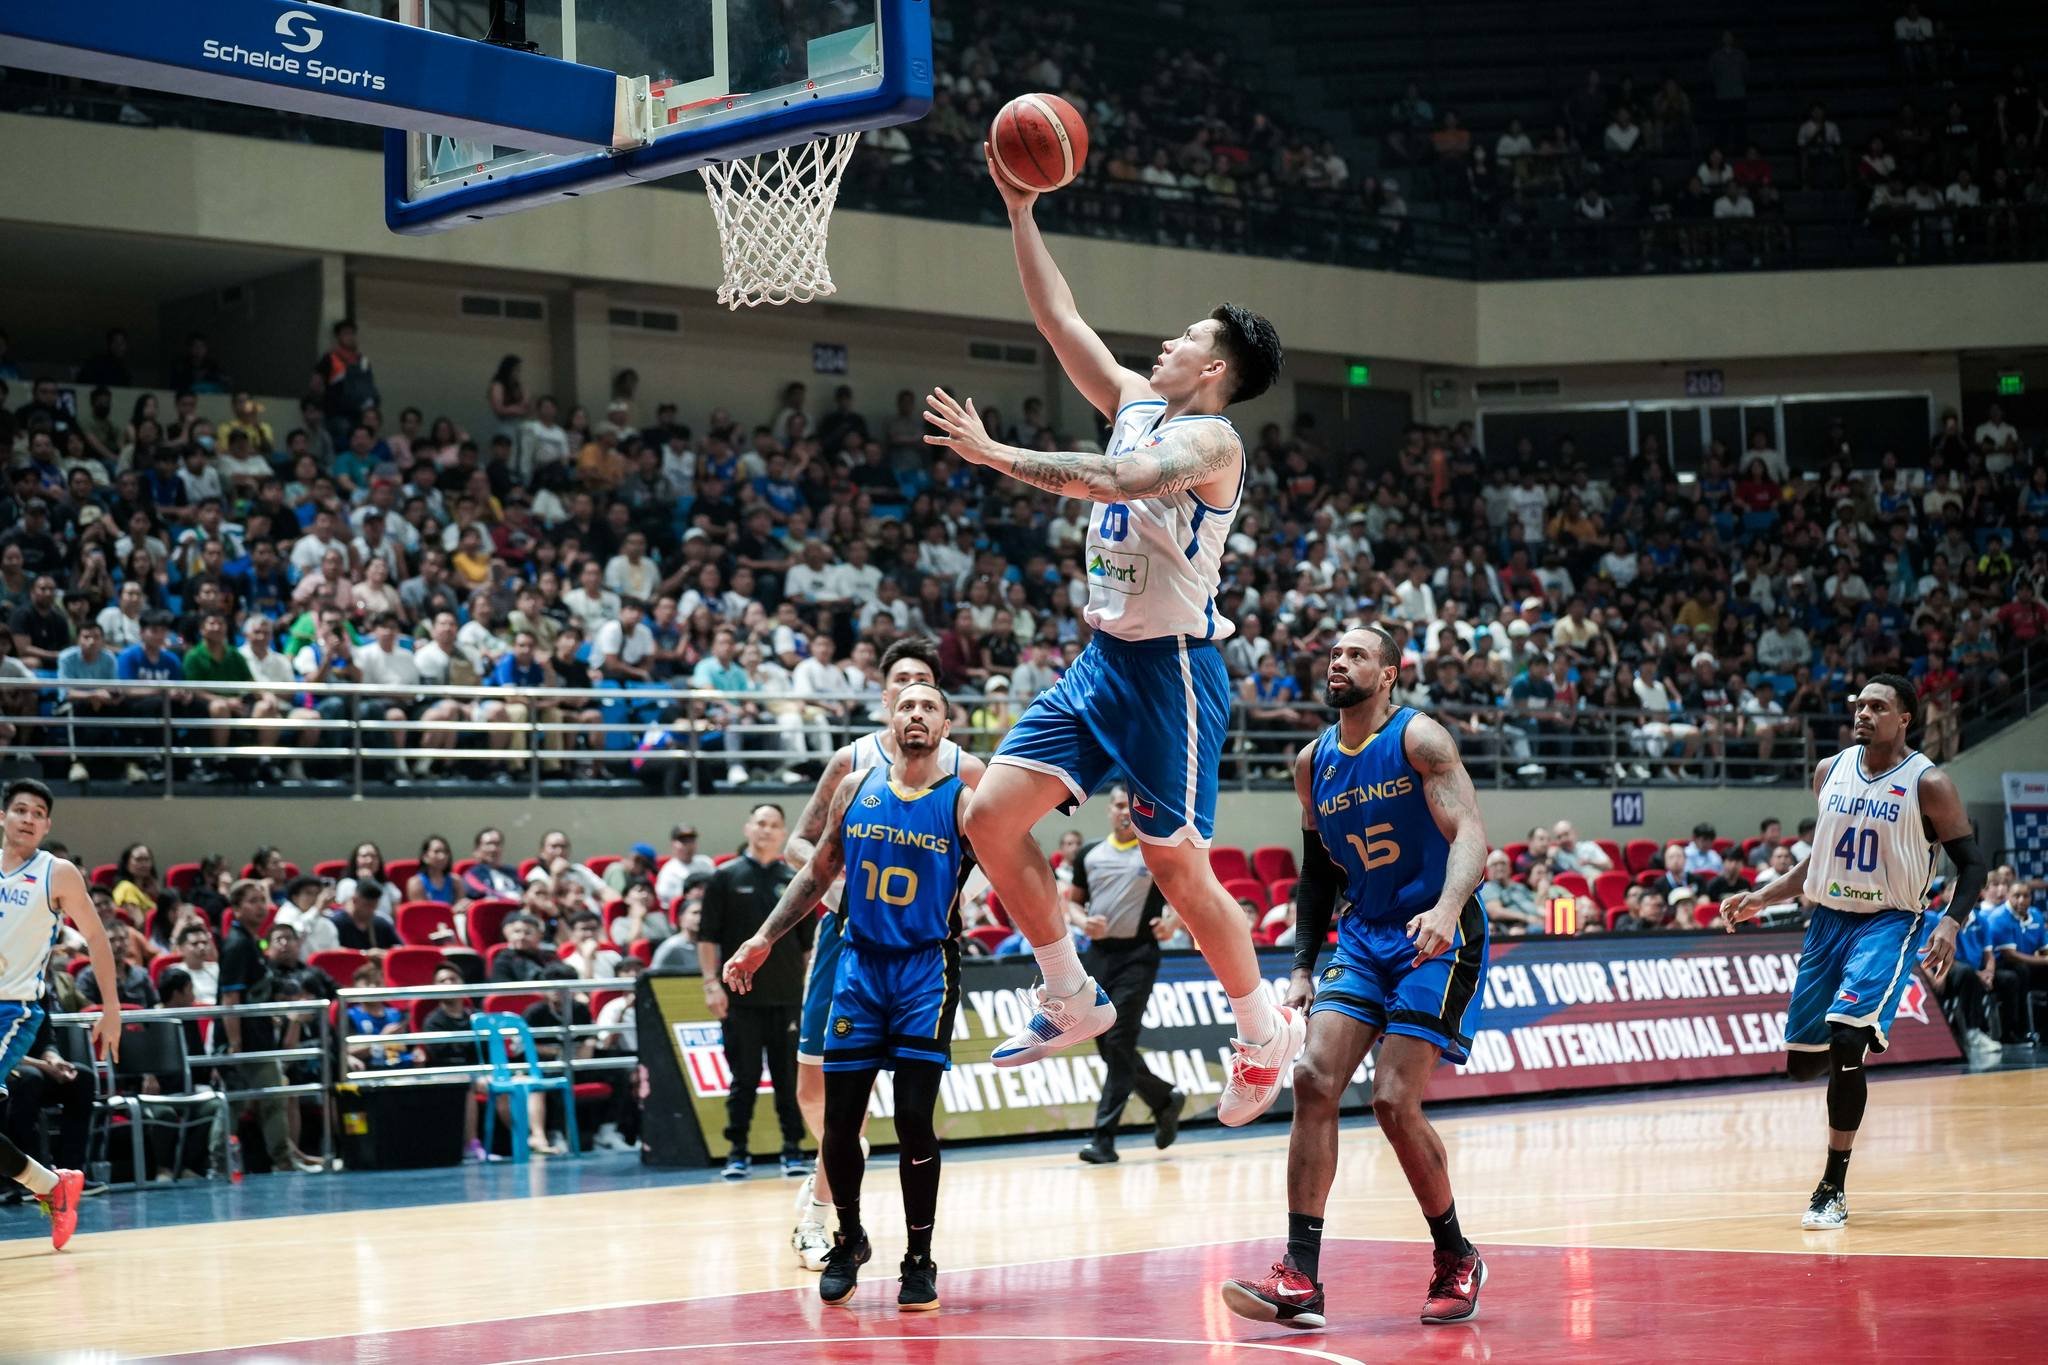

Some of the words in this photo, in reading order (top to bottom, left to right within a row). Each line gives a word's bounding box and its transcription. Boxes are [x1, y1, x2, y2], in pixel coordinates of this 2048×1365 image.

[203, 40, 299, 74] Schelde
[306, 59, 385, 91] Sports
[1688, 374, 1722, 393] 205
[1105, 559, 1136, 584] Smart
[1317, 776, 1413, 816] MUSTANGS
[1614, 796, 1642, 822] 101
[1827, 794, 1900, 822] PILIPINAS
[846, 823, 950, 854] MUSTANGS
[1346, 822, 1400, 872] 15
[1834, 826, 1879, 873] 40
[861, 860, 918, 906] 10
[1843, 886, 1883, 901] Smart
[1531, 961, 1615, 1006] YOUR
[1608, 956, 1740, 1002] FAVORITE
[1732, 953, 1802, 996] LOCA
[1511, 1015, 1735, 1071] INTERNATIONAL
